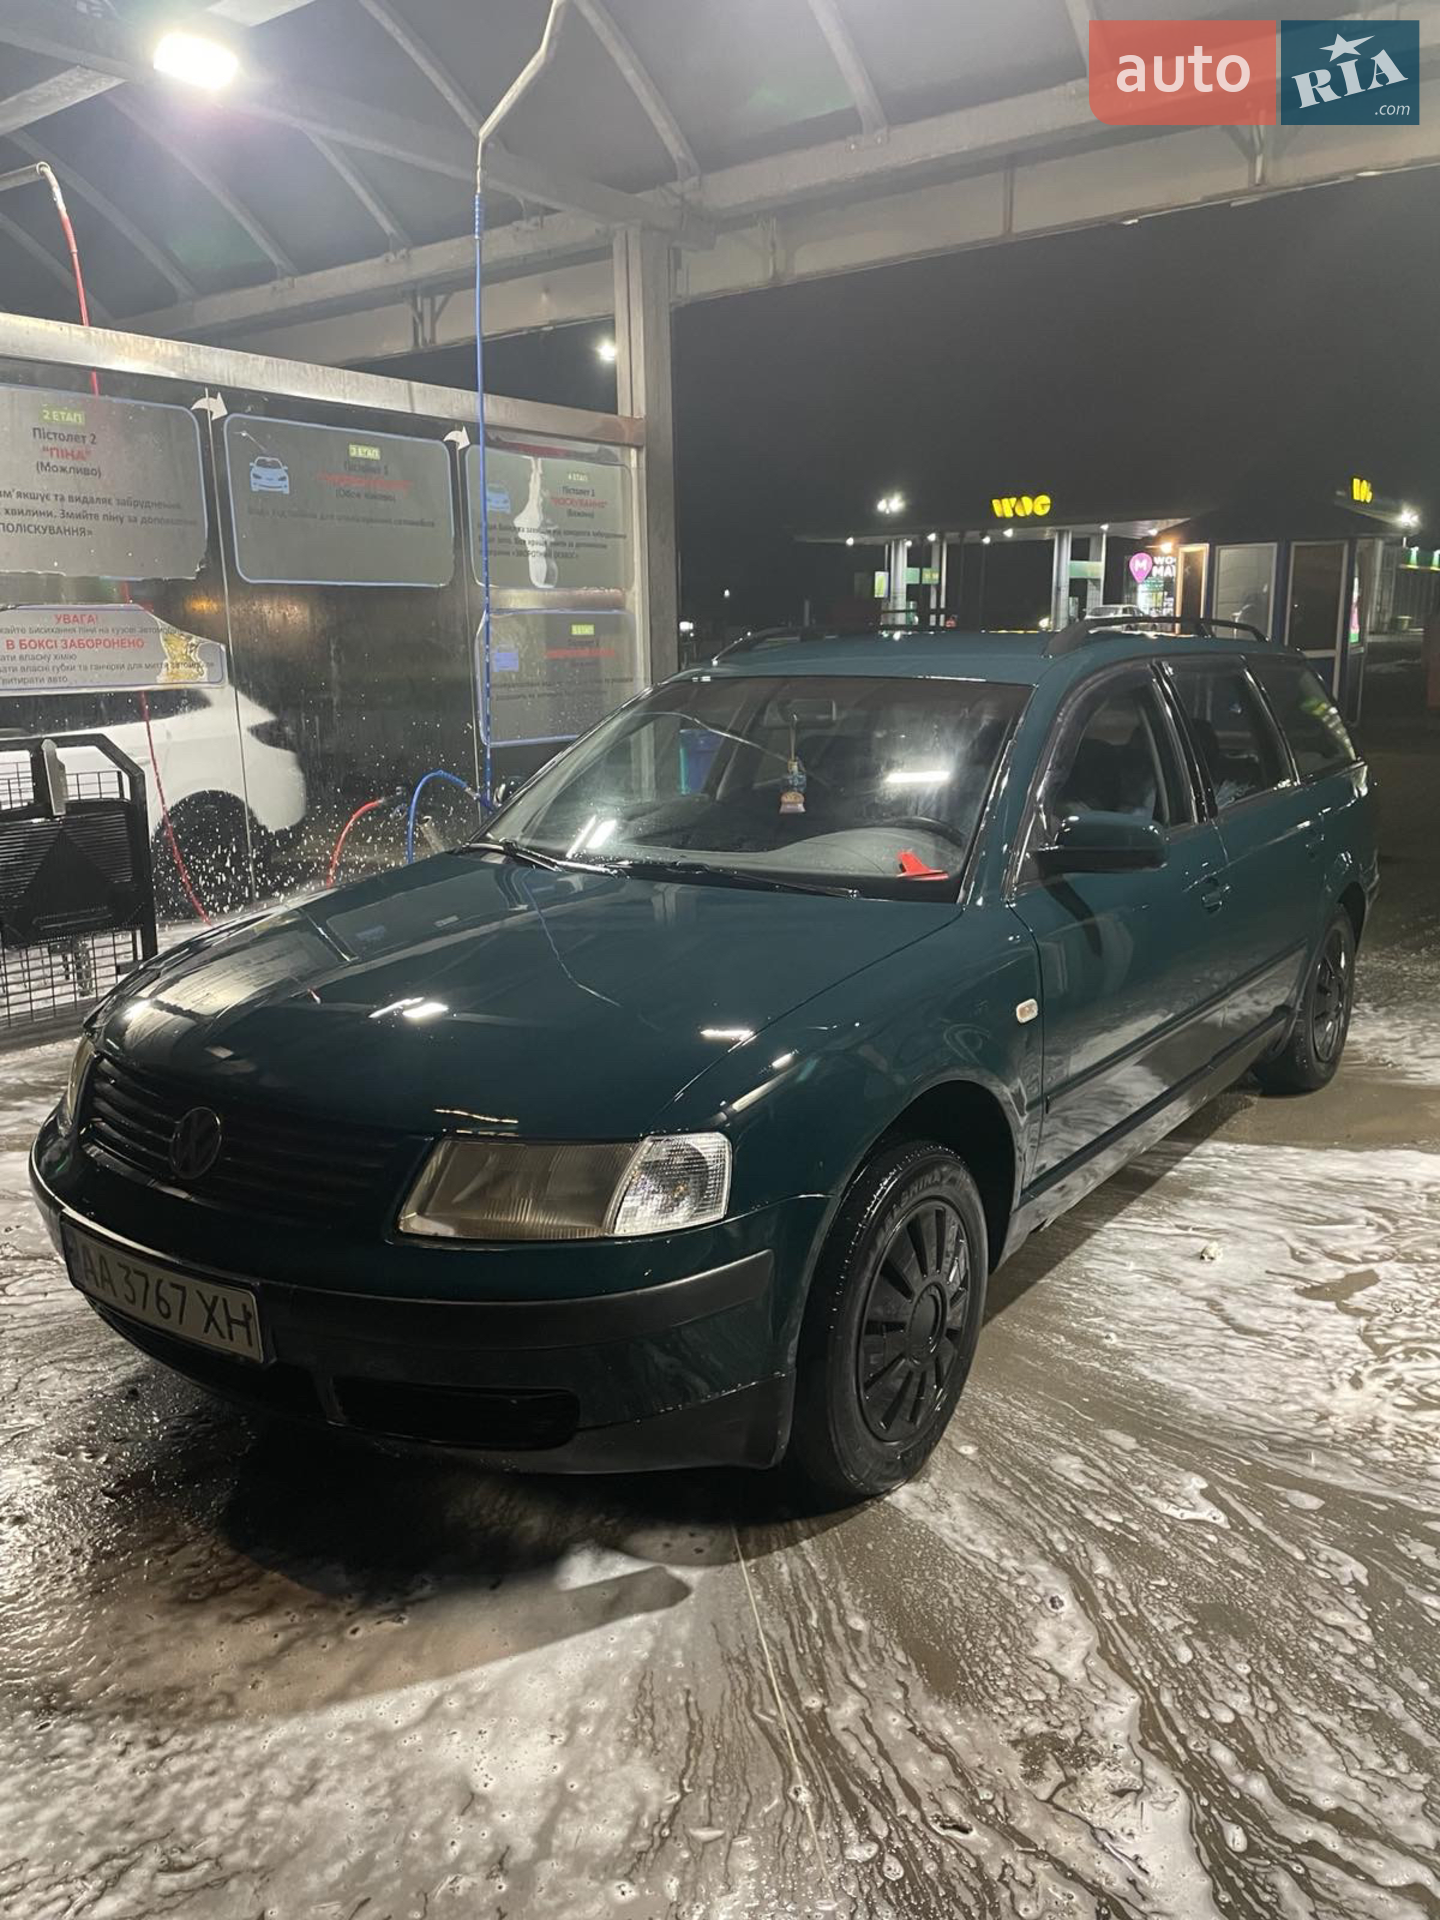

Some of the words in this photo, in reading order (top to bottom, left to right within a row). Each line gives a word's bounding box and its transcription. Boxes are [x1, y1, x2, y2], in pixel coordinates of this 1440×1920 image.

[52, 410, 83, 423] ЕТАП
[32, 427, 87, 445] Пістолет
[90, 432, 97, 445] 2
[36, 460, 102, 479] (Можливо)
[991, 494, 1051, 518] WOG
[1134, 558, 1148, 572] M
[1153, 555, 1177, 565] WO
[6, 639, 15, 650] В
[19, 639, 58, 650] БОКСІ
[61, 637, 145, 650] ЗАБОРОНЕНО
[80, 1242, 118, 1298] AA
[117, 1261, 187, 1326] 3767
[196, 1289, 253, 1348] XH
